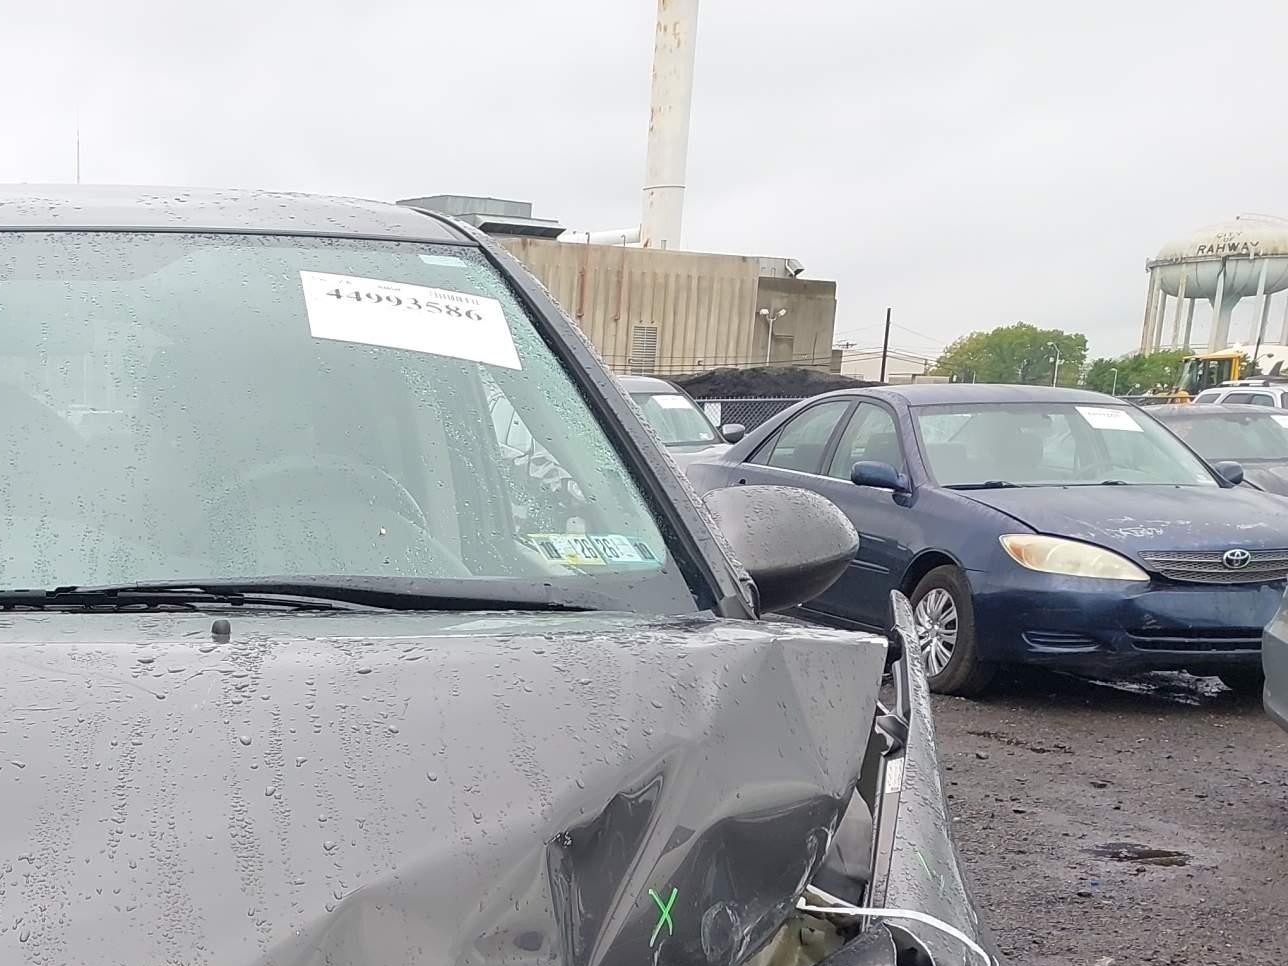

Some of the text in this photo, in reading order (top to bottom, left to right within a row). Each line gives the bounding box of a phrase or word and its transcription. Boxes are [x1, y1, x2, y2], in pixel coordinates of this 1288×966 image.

[1196, 241, 1260, 255] RAHWAY
[325, 288, 484, 322] 44993586
[574, 538, 600, 559] 26
[594, 538, 621, 559] 26
